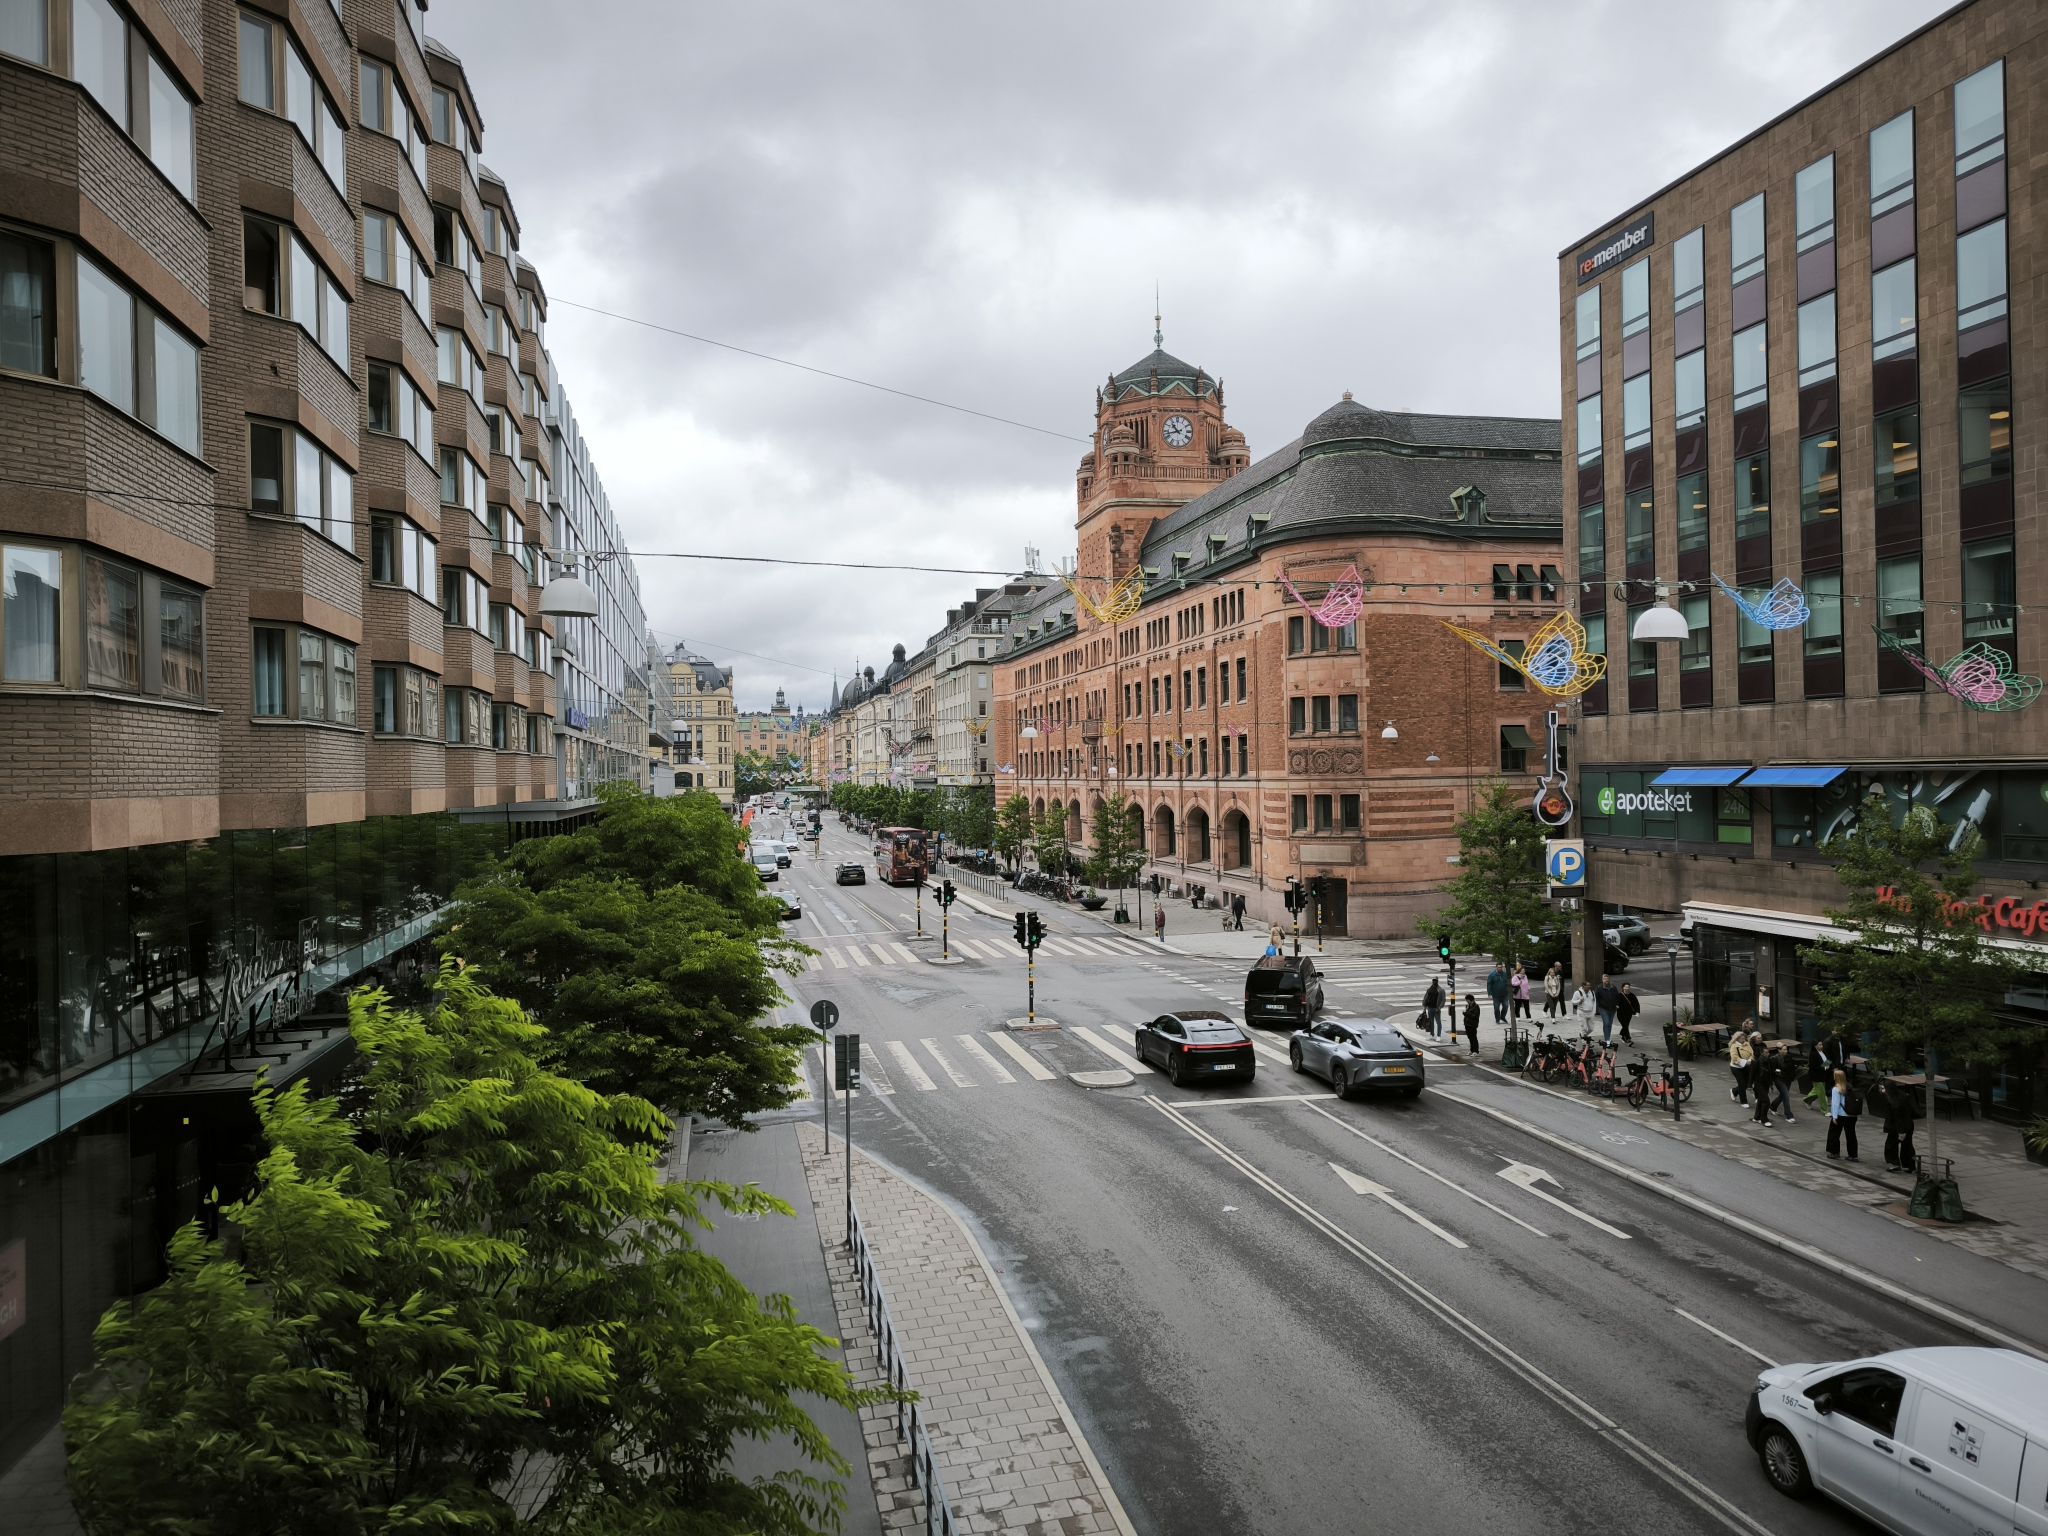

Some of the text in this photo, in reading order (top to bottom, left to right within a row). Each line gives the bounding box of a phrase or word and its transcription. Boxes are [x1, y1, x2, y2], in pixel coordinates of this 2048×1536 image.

[1616, 788, 1693, 815] apoteket
[1723, 799, 1745, 815] 24h
[1558, 851, 1581, 878] P
[1935, 891, 1994, 931] Rok
[303, 937, 318, 954] BLU
